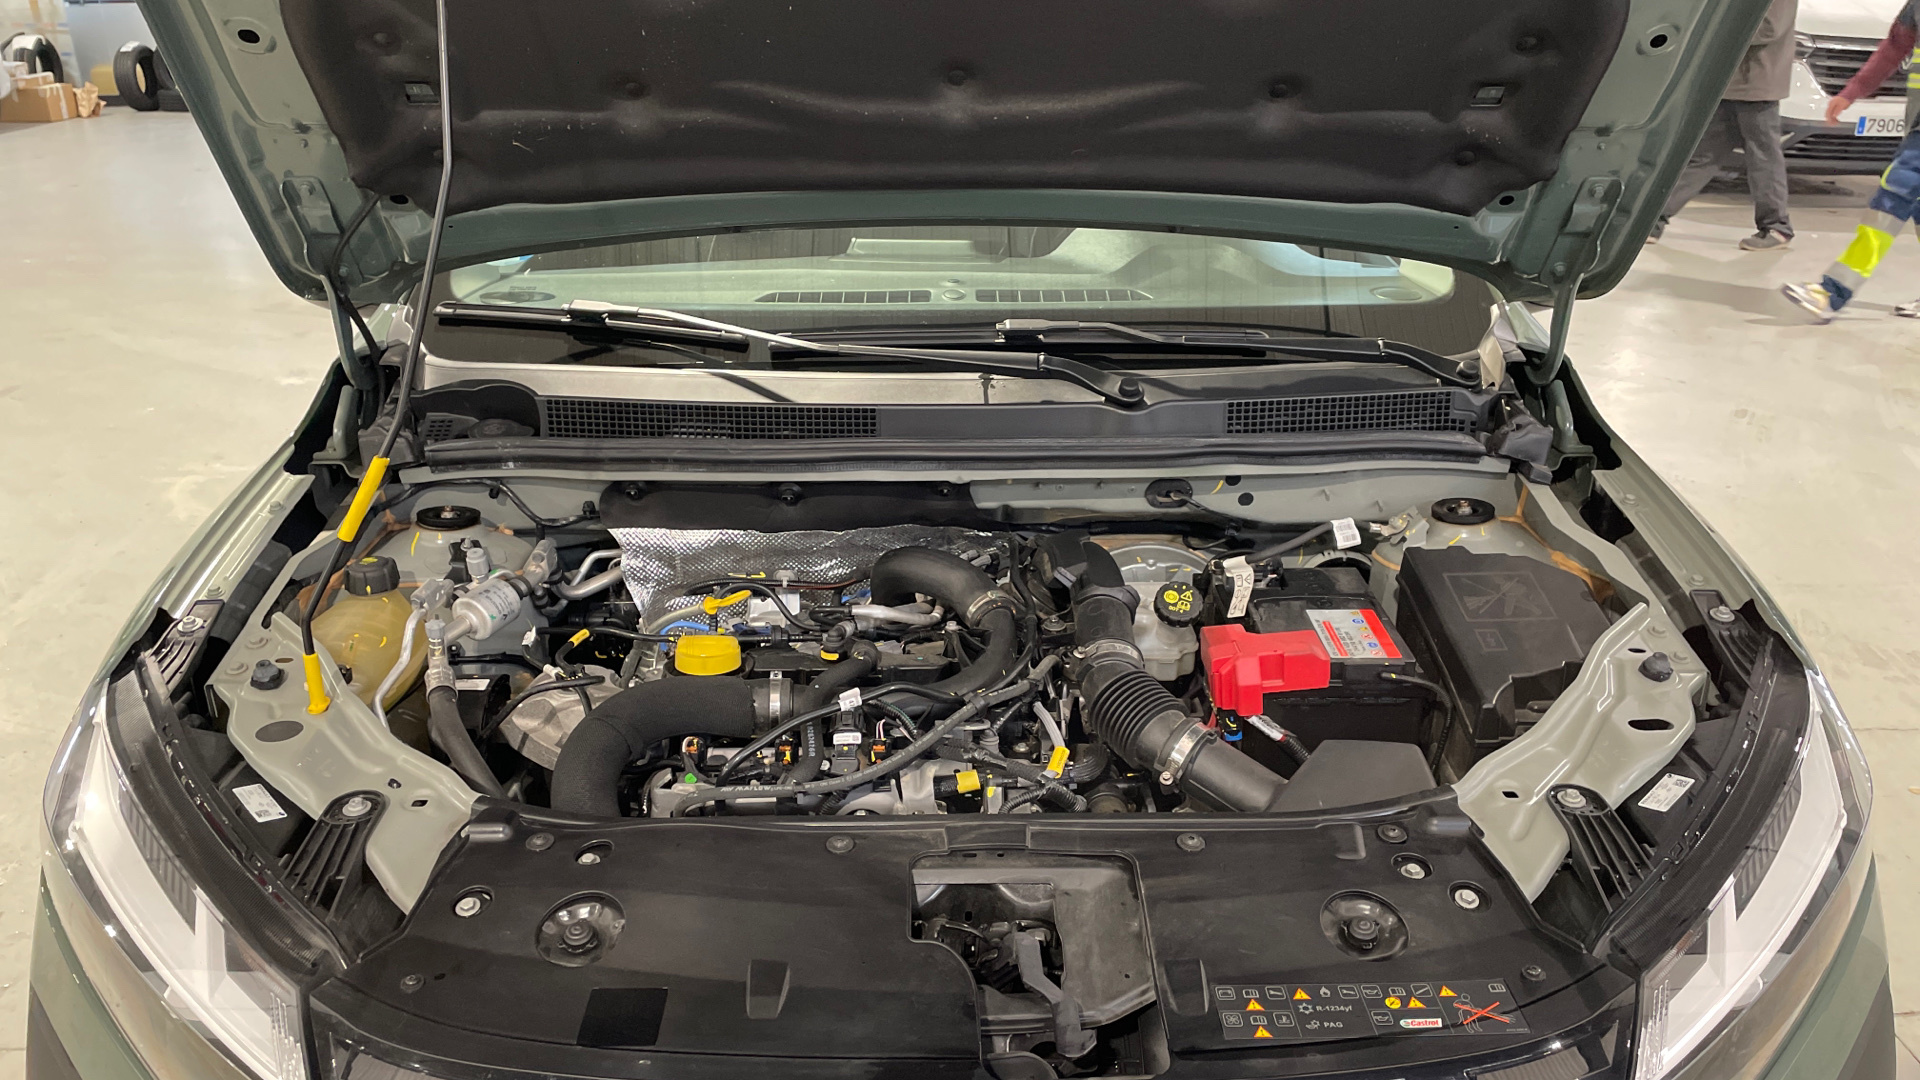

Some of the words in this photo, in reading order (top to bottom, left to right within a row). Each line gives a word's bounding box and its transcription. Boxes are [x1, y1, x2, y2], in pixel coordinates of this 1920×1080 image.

[1866, 118, 1905, 133] 7906
[1315, 1004, 1353, 1013] R-1234yf
[1410, 1019, 1440, 1027] Castrol
